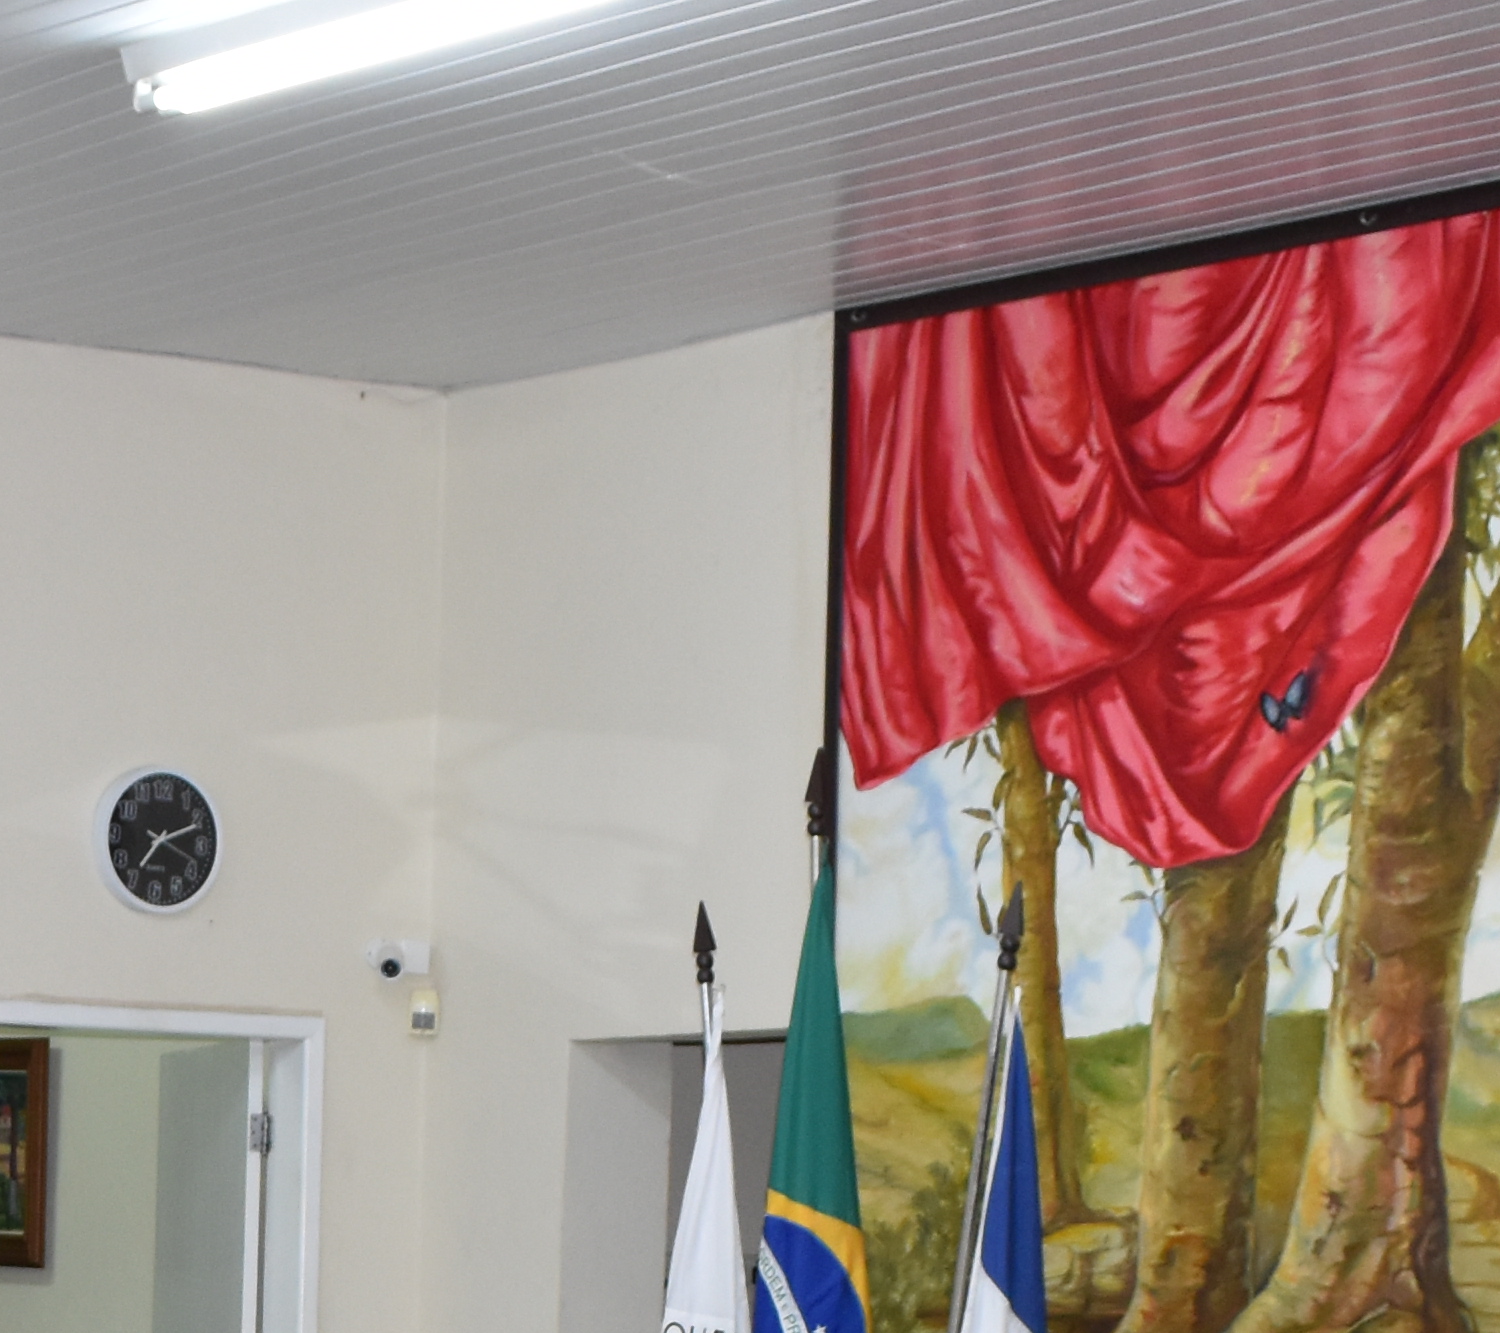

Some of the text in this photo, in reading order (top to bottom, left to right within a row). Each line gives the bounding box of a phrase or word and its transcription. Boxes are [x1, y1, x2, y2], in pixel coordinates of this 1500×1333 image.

[135, 782, 151, 804] 11
[153, 780, 174, 802] 12
[181, 787, 191, 811] 1
[119, 801, 137, 821] 10
[192, 808, 203, 829] 2
[110, 823, 121, 845] 9
[195, 835, 208, 857] 3
[113, 848, 128, 869] 8
[127, 868, 139, 890] 7
[184, 860, 198, 880] 4
[147, 880, 162, 902] 6
[169, 875, 183, 896] 5
